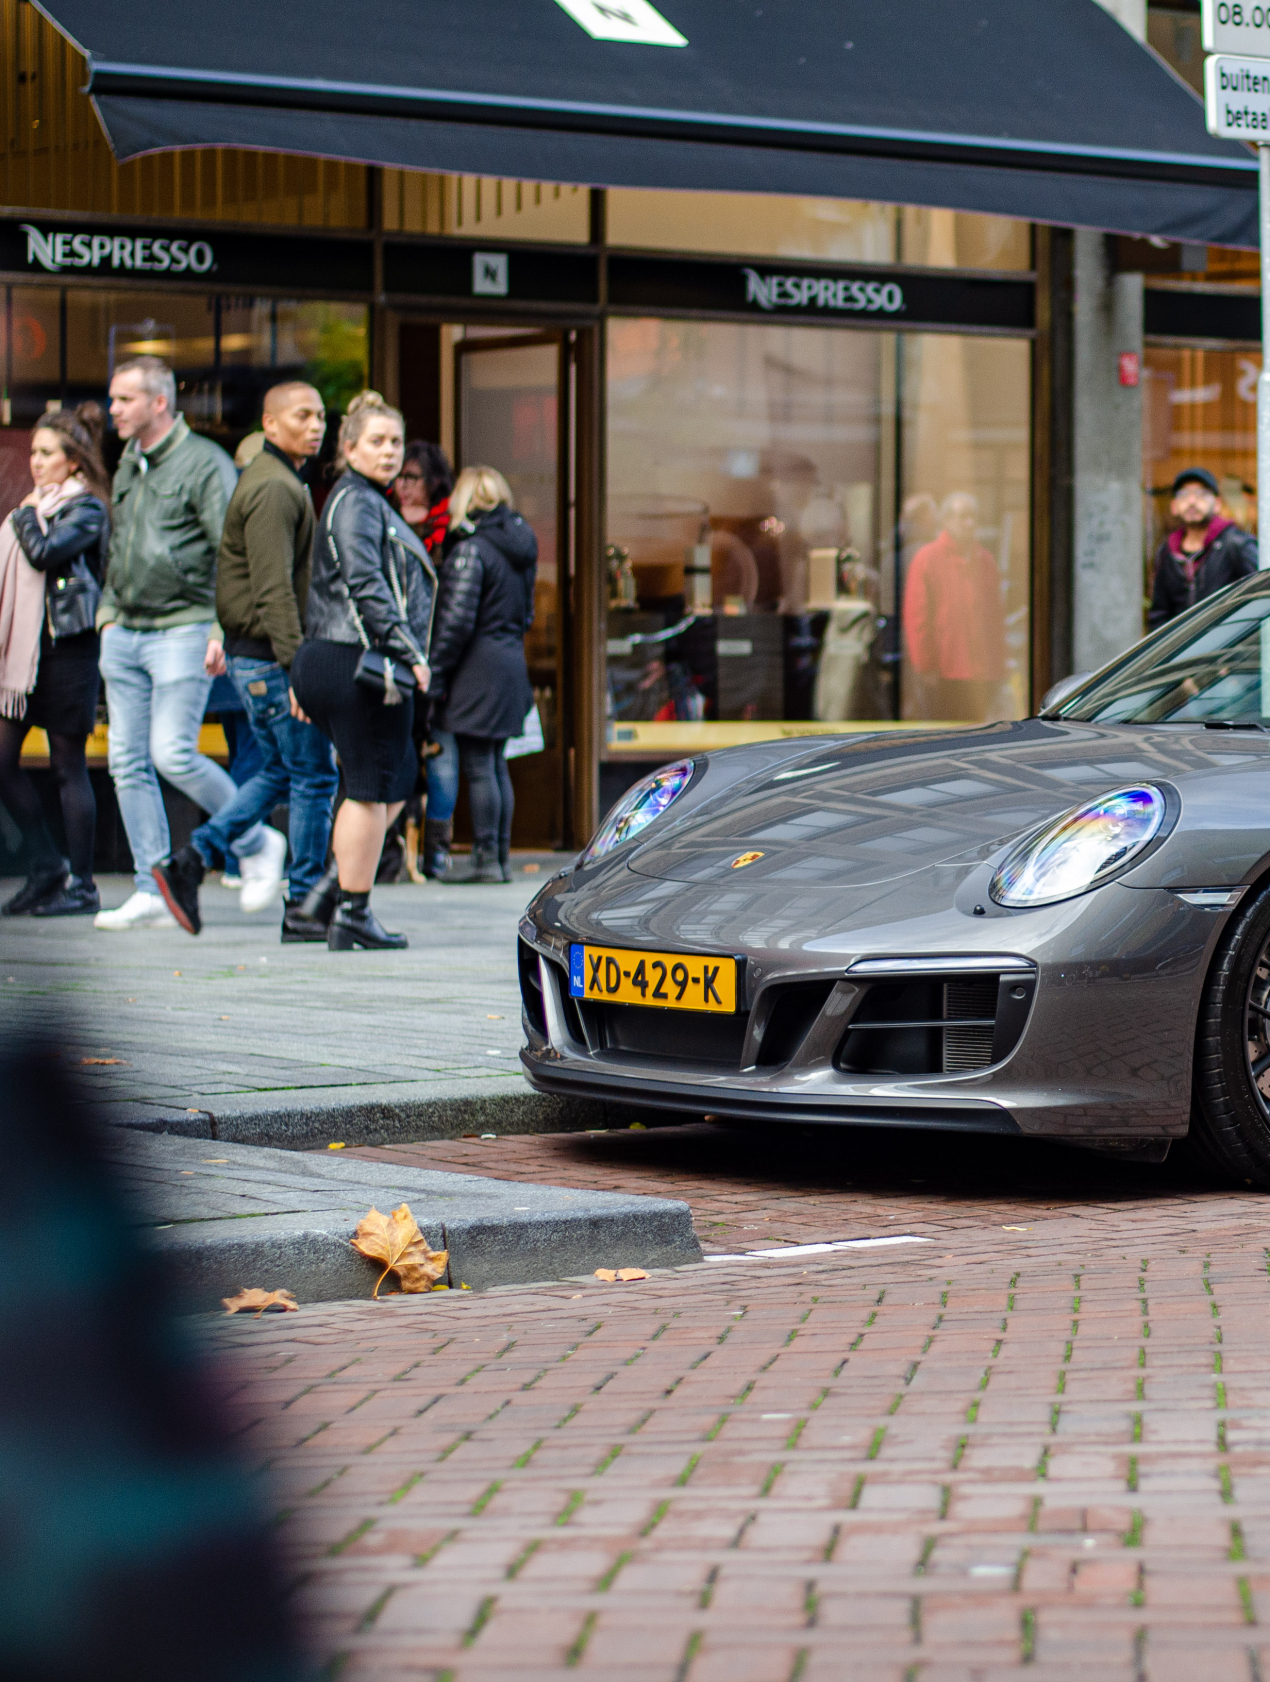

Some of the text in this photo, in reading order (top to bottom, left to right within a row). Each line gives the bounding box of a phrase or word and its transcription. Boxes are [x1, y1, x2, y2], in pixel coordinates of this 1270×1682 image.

[1219, 66, 1270, 95] buiten
[20, 224, 214, 273] NESPRESSO
[742, 267, 903, 313] NESPRESSO
[573, 975, 584, 988] NL
[588, 953, 723, 1005] XD-429-K
